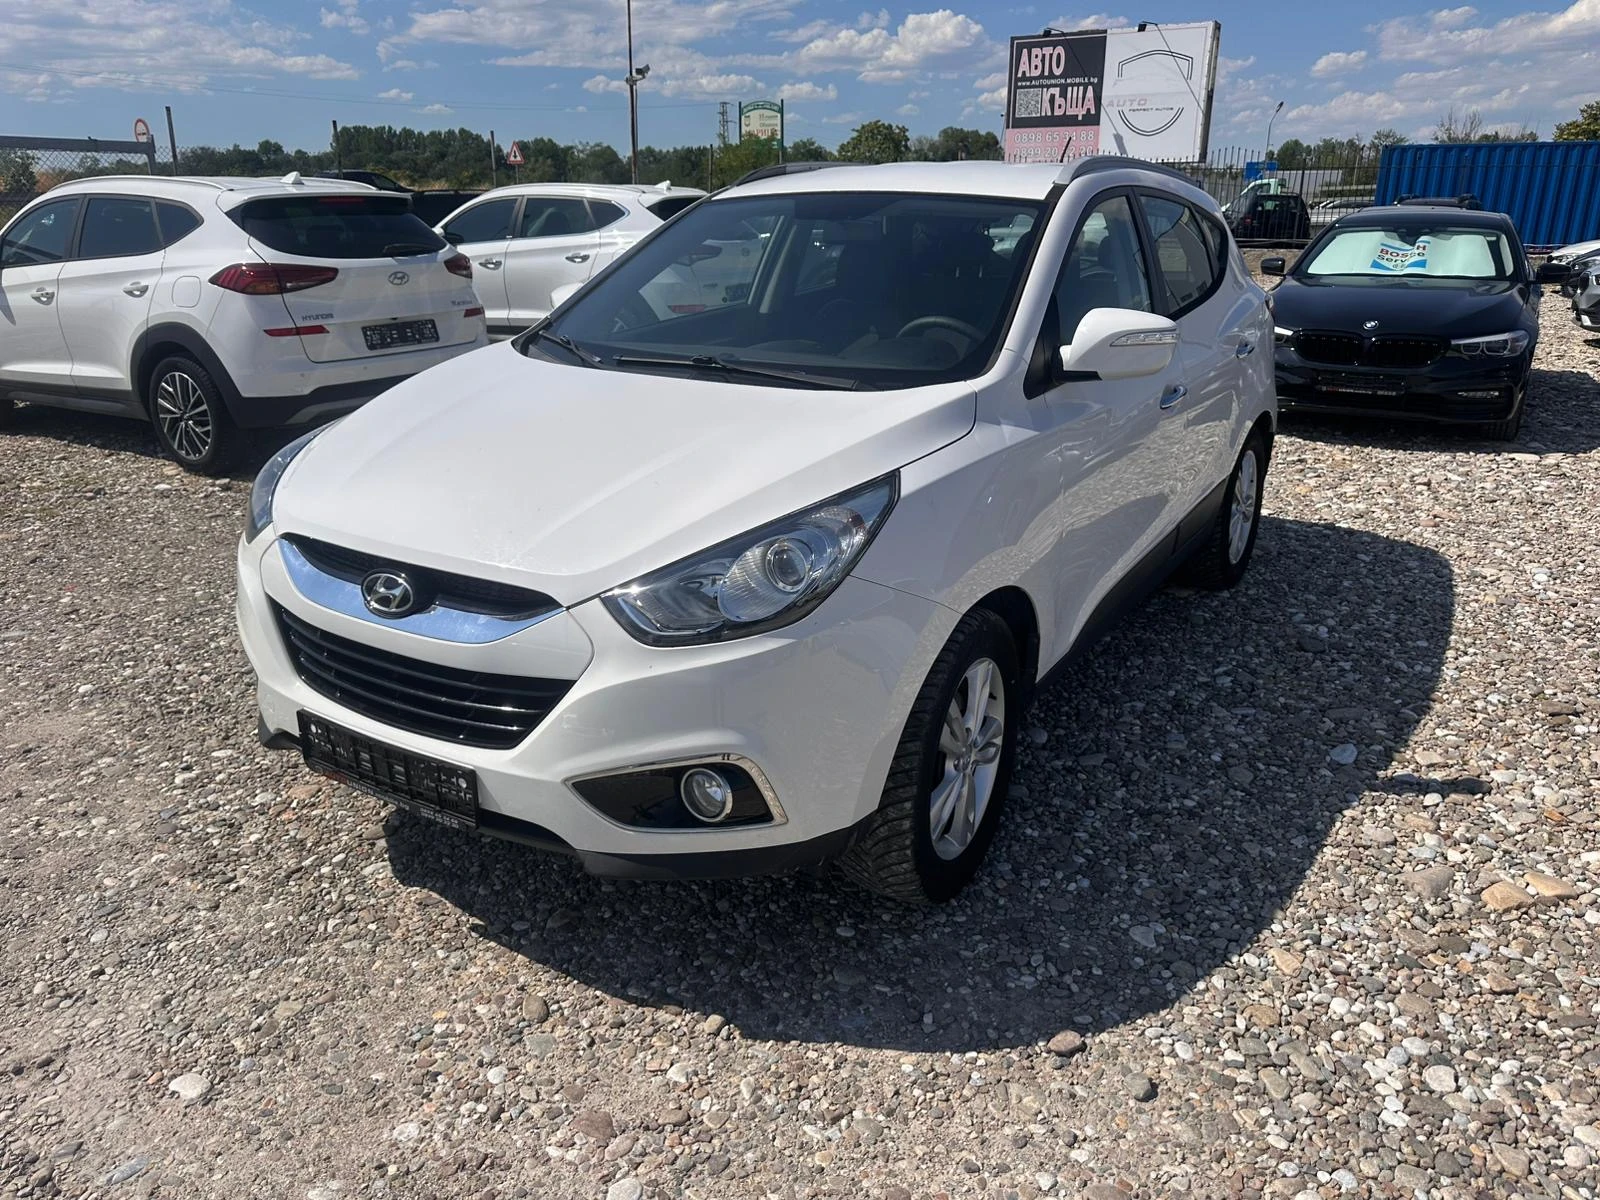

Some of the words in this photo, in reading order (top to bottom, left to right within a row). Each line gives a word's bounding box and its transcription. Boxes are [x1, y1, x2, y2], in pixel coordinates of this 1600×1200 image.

[1017, 46, 1066, 77] АВТО
[1041, 85, 1096, 120] КЪЩА
[1106, 98, 1148, 108] AUTO
[1014, 132, 1042, 143] 0898
[1045, 132, 1059, 142] 65
[1080, 130, 1094, 141] 88
